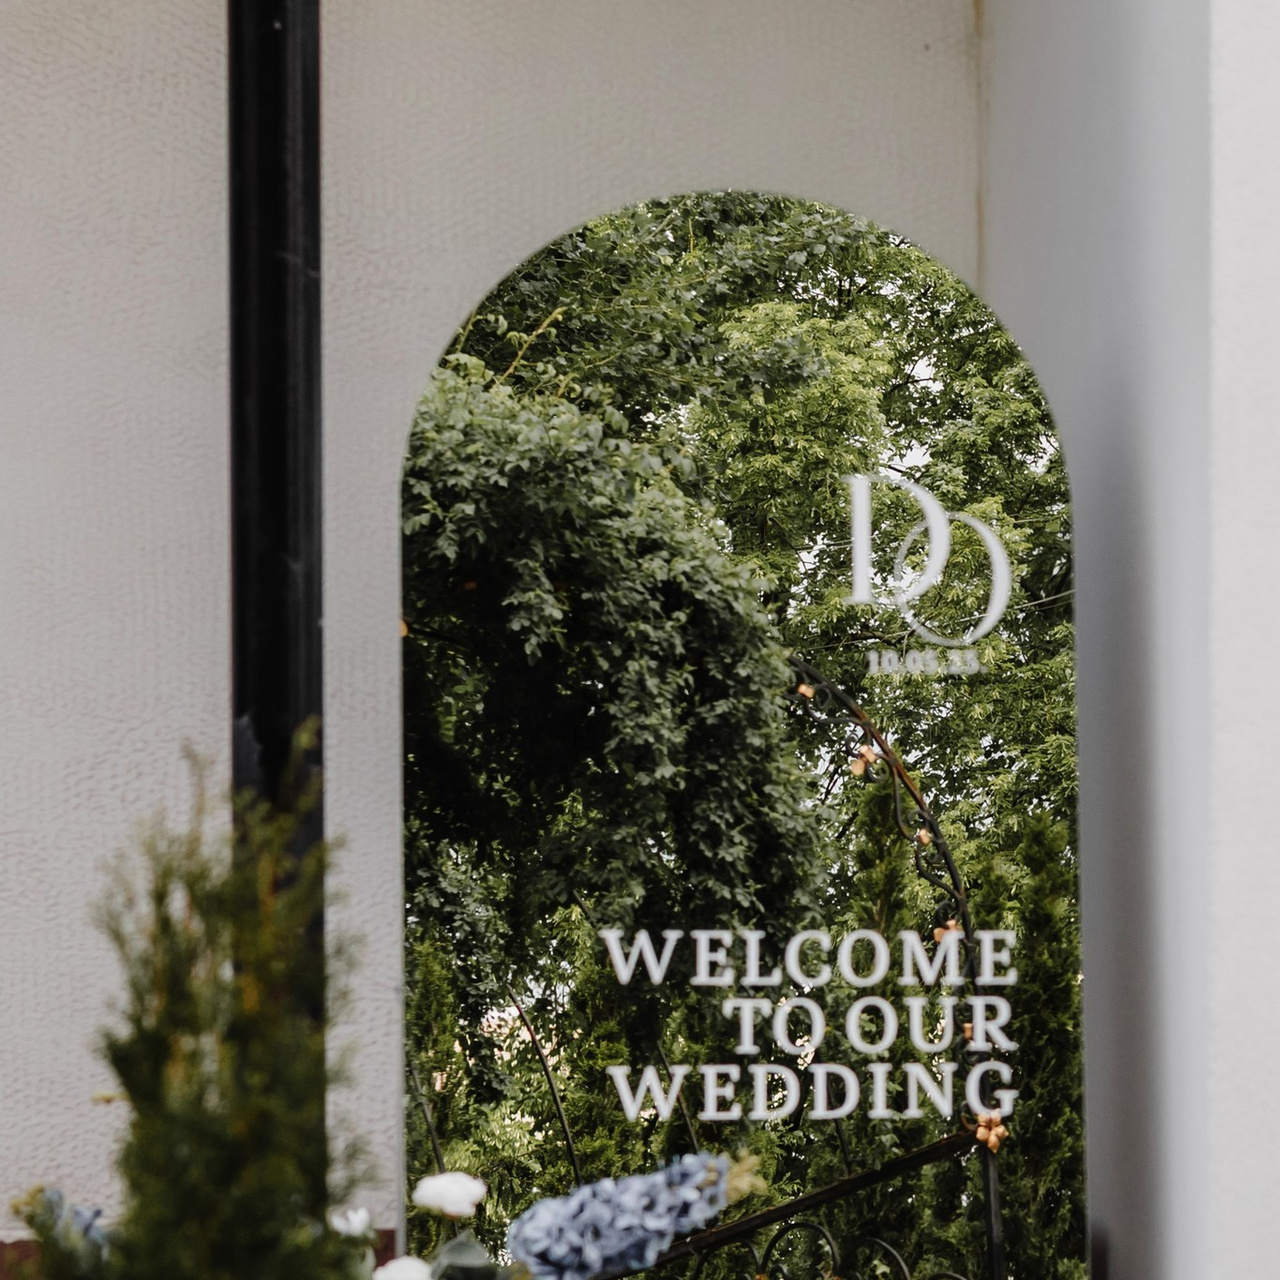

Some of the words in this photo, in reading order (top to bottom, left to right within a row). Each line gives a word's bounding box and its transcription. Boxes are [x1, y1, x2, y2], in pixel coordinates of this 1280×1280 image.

[601, 928, 1018, 986] WELCOME
[723, 997, 826, 1054] TO
[846, 995, 1017, 1053] OUR
[607, 1060, 1018, 1120] WEDDING
